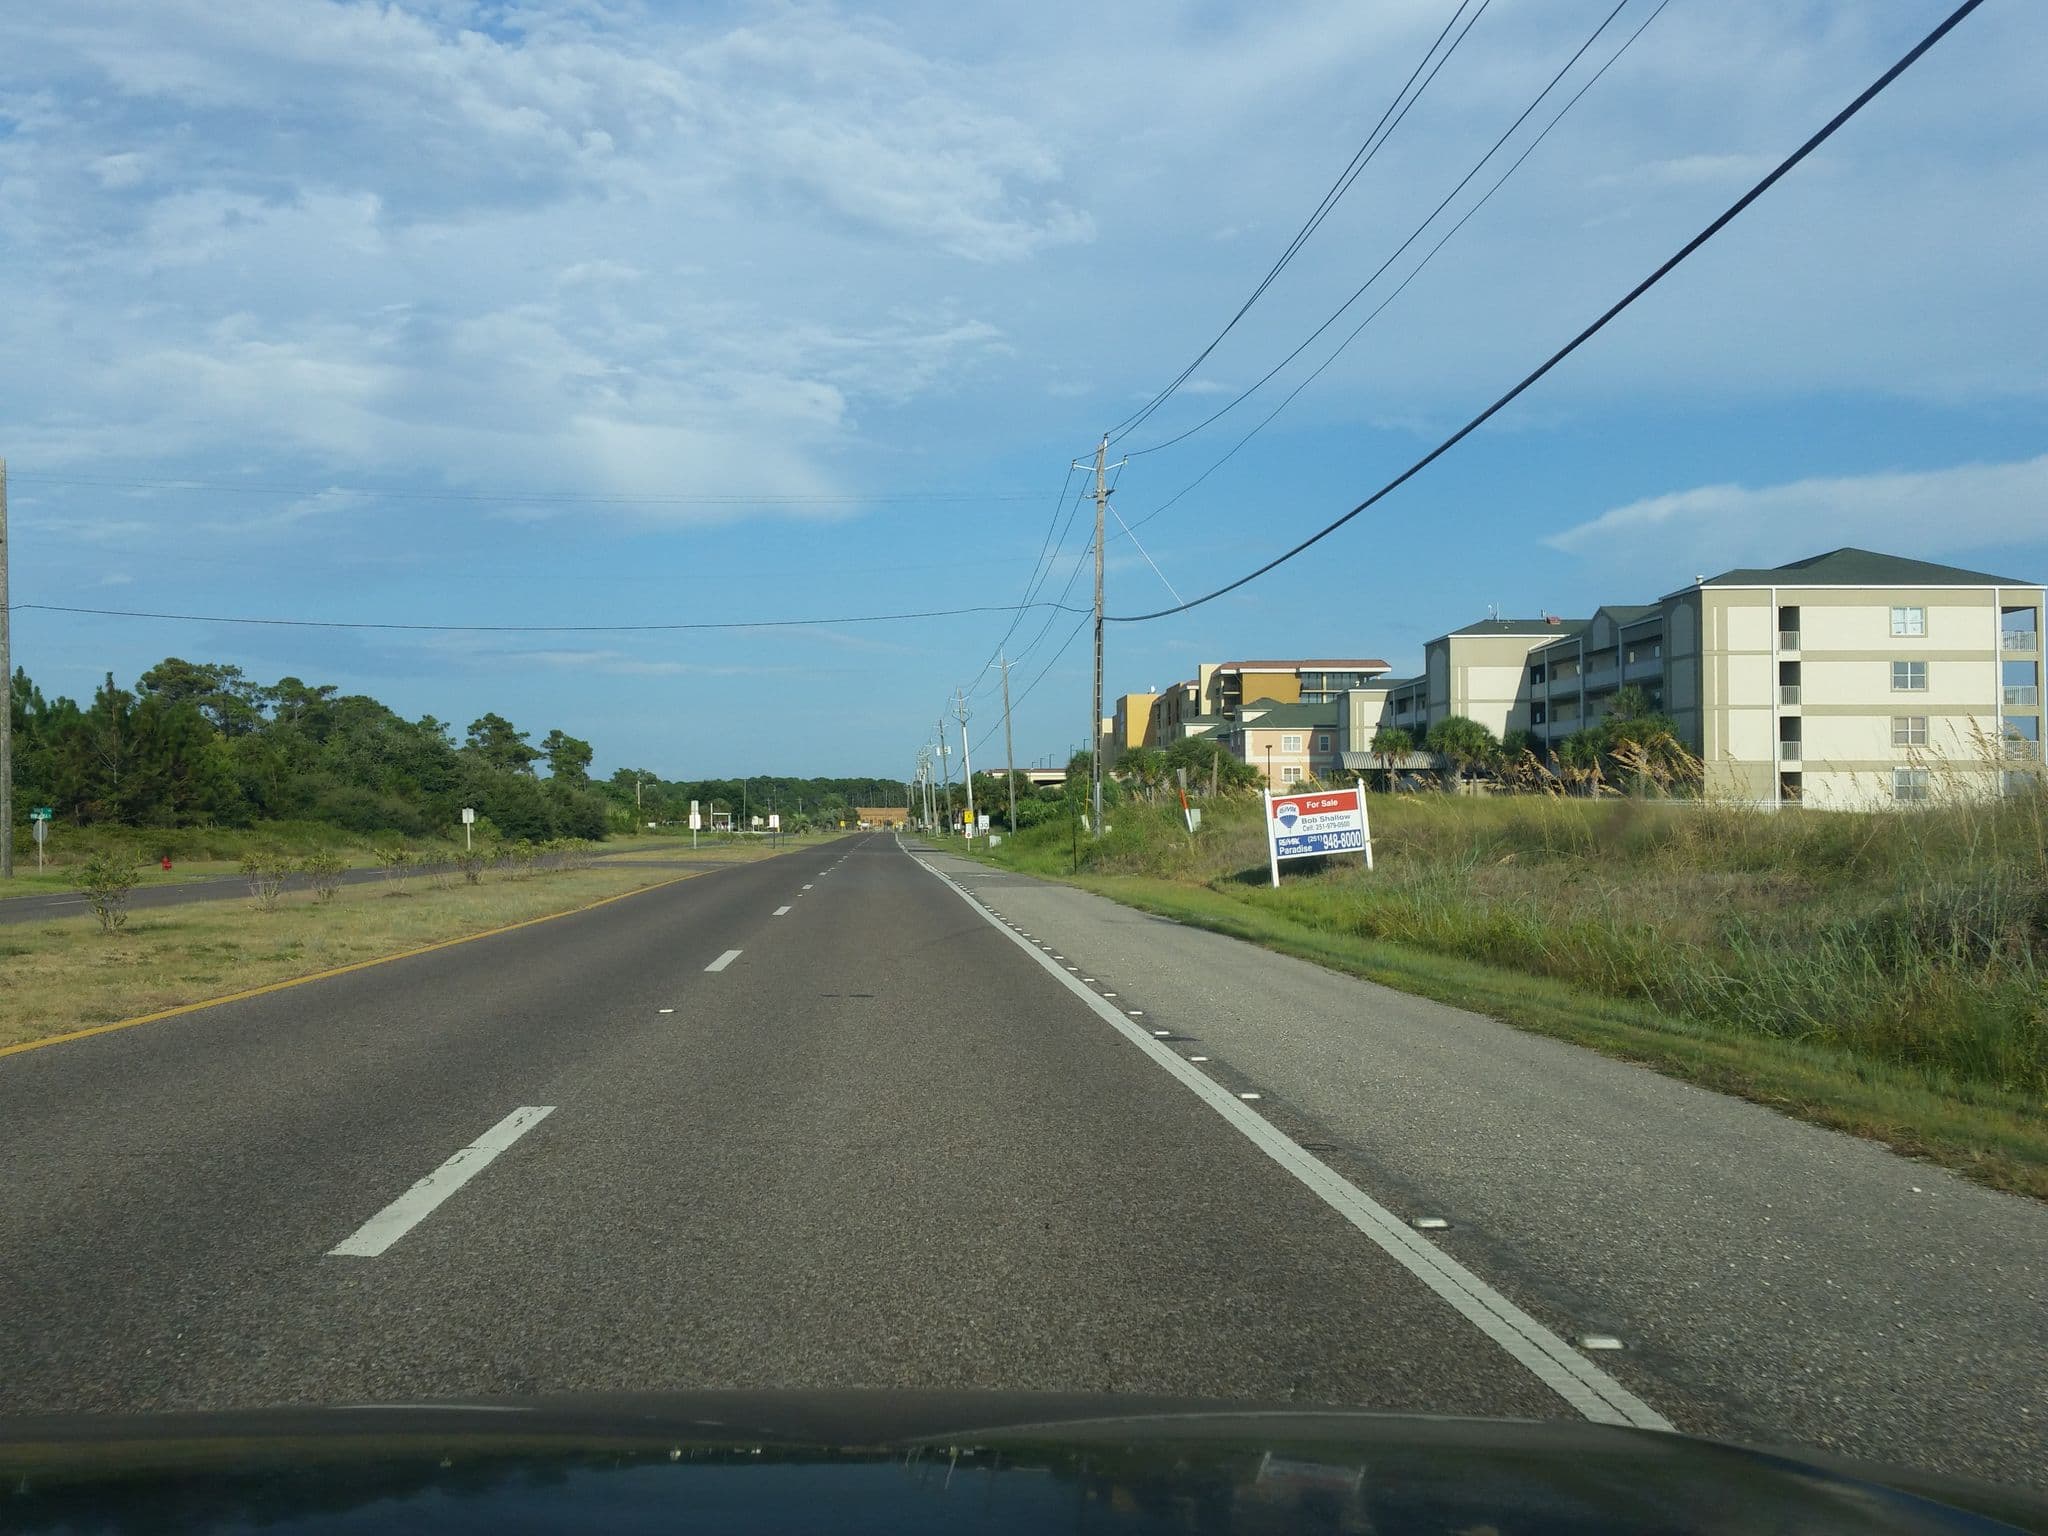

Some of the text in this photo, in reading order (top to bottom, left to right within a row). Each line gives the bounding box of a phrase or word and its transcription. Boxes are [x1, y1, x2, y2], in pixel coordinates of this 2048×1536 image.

[1321, 799, 1338, 807] Sale
[1319, 814, 1351, 822] Shallow
[1308, 834, 1322, 842] (251)
[1323, 831, 1361, 849] 948-8000
[1279, 845, 1312, 855] Paradise
